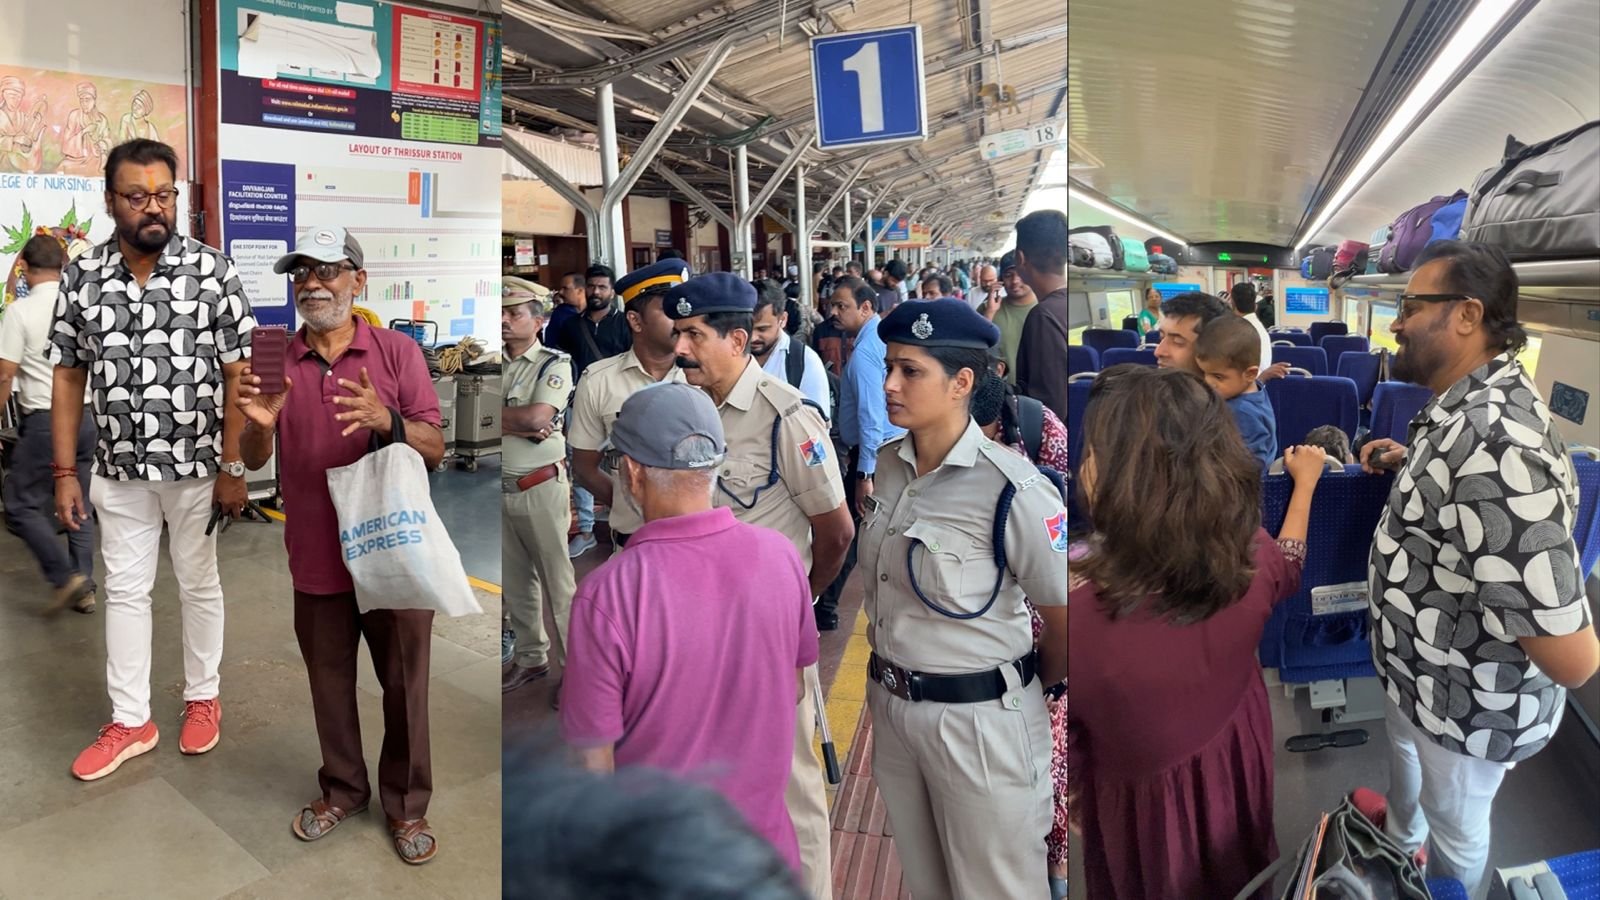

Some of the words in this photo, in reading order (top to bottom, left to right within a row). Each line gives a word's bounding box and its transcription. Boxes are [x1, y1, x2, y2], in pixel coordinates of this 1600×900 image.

[298, 3, 325, 14] SUPPORTED
[842, 42, 885, 134] 1
[1037, 126, 1054, 142] 18
[349, 144, 380, 154] LAYOUT
[381, 146, 392, 155] OF
[394, 147, 431, 158] THRISSUR
[432, 150, 462, 160] STATION
[0, 175, 21, 188] EGE
[26, 176, 38, 188] OF
[341, 510, 426, 544] AMERICAN
[345, 530, 422, 560] EXPRESS
